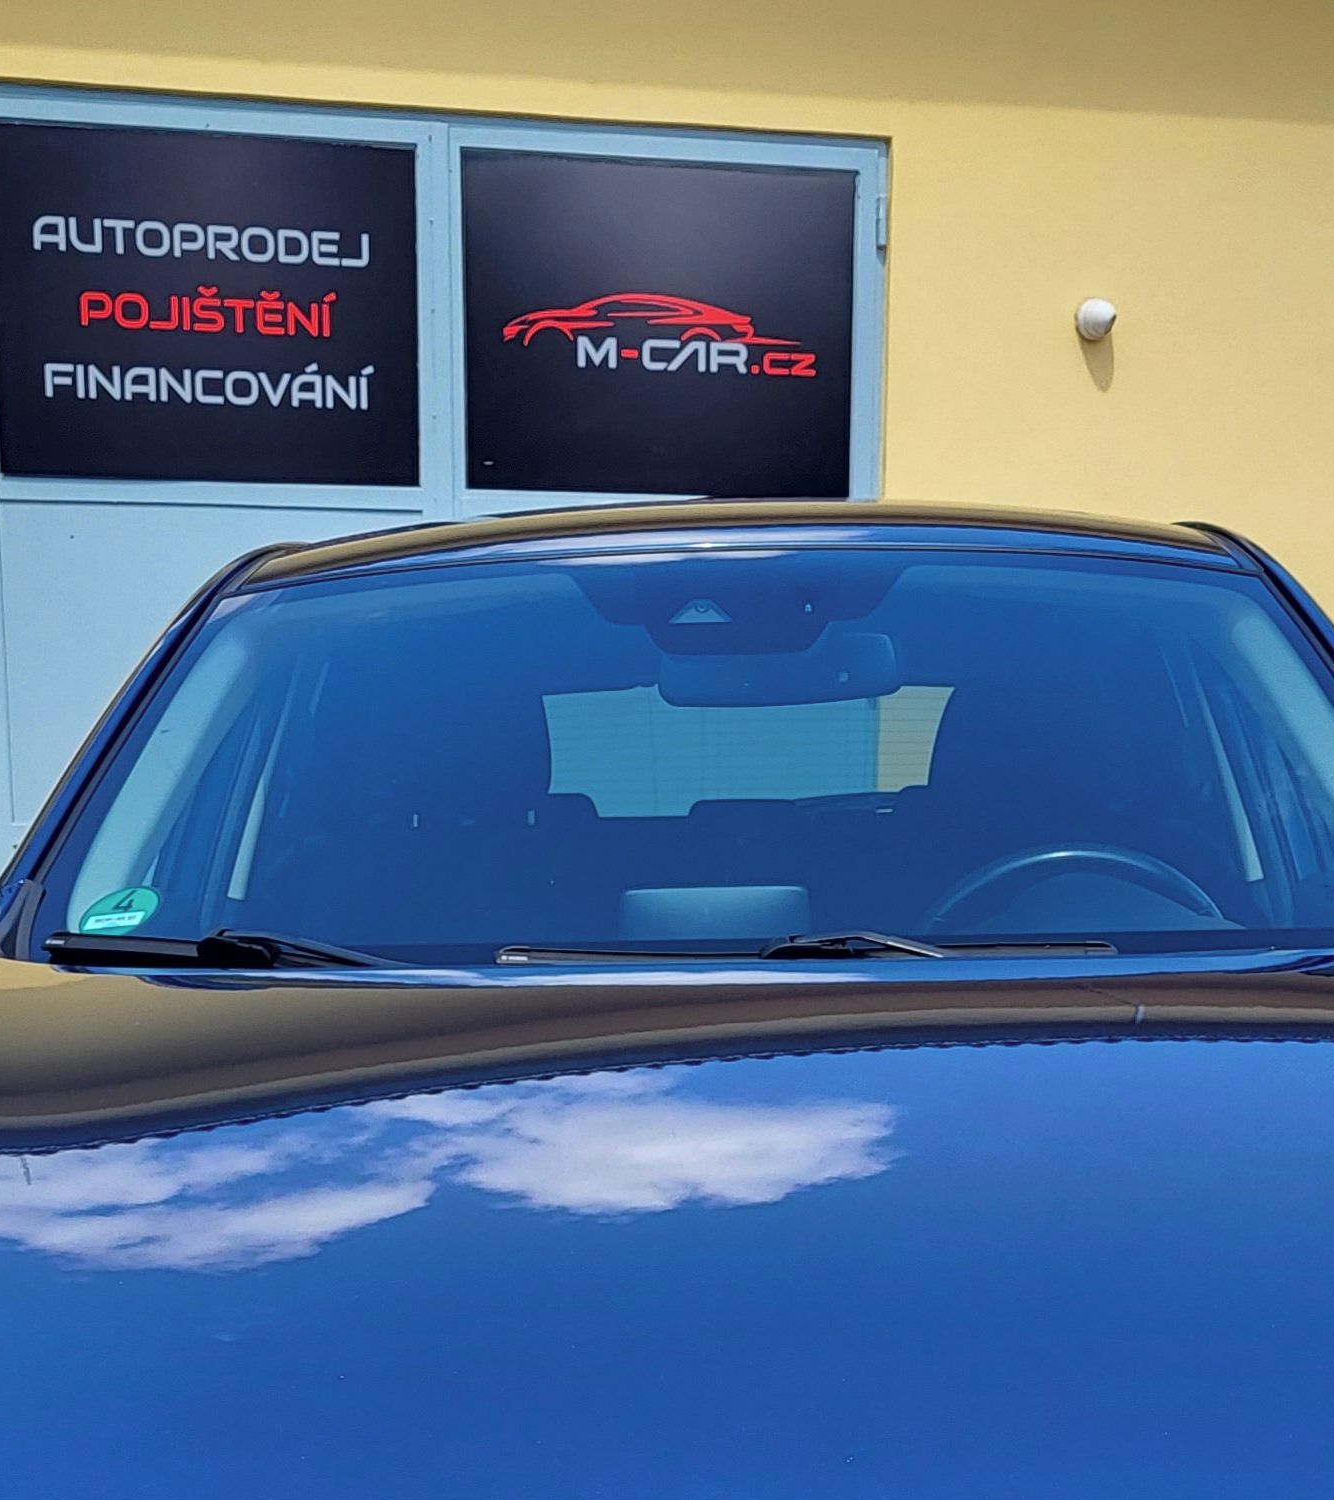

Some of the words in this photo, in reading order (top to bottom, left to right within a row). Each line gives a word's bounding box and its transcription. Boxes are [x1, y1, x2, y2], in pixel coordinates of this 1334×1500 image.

[32, 215, 370, 268] AUTOPRODEJ
[78, 285, 338, 338] POJIŠTĚNÍ
[43, 362, 375, 411] FINANCOVÁNÍ
[111, 889, 137, 913] 4
